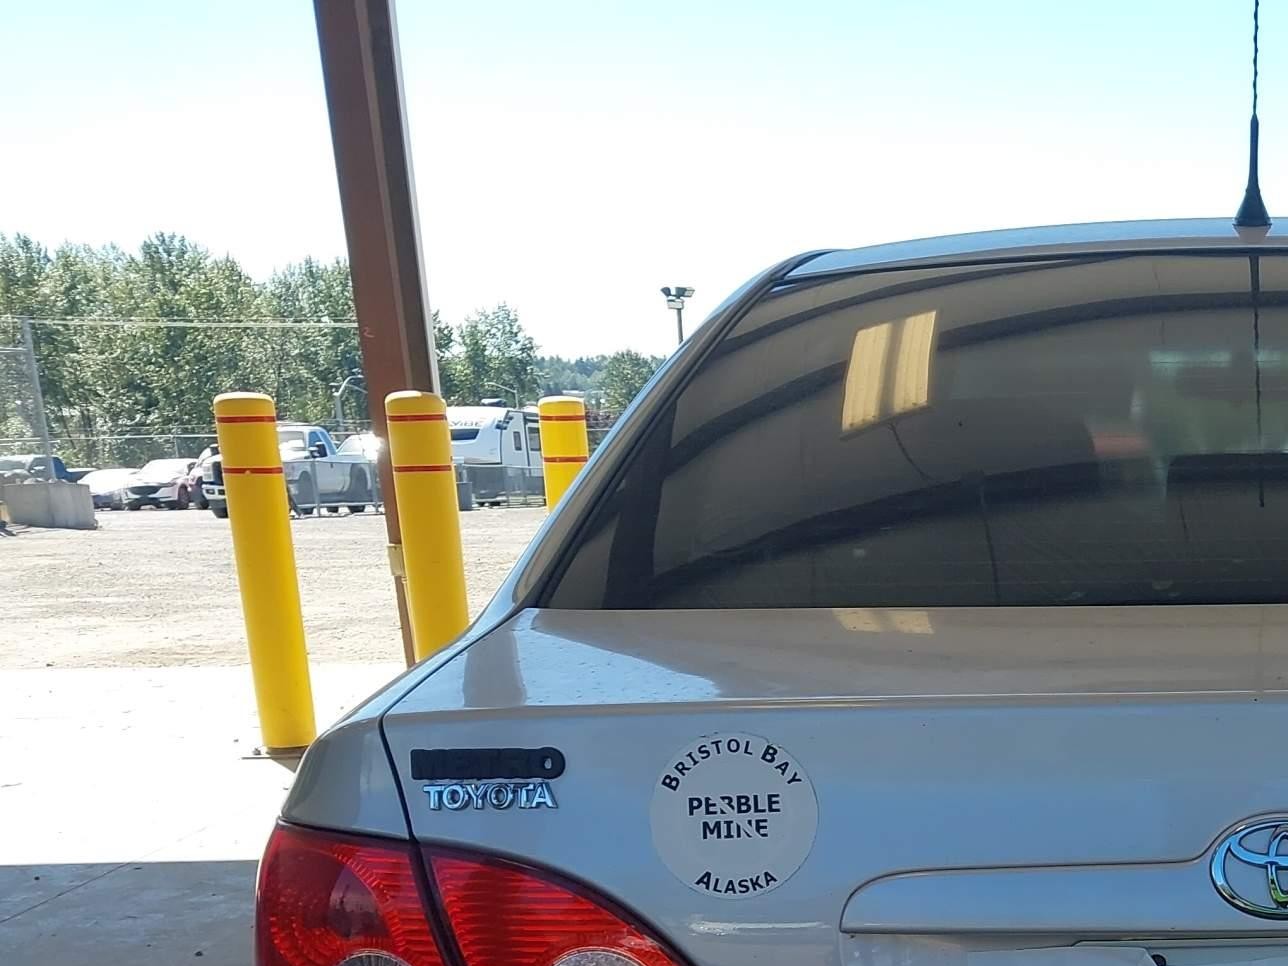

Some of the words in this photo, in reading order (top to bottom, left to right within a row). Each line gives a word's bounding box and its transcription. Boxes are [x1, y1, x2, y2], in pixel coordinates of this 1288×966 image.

[661, 738, 754, 792] BRISTOL
[760, 743, 803, 787] BAY
[423, 782, 558, 810] TOYOTA
[702, 817, 769, 840] MINE
[694, 870, 778, 895] ALASKA
